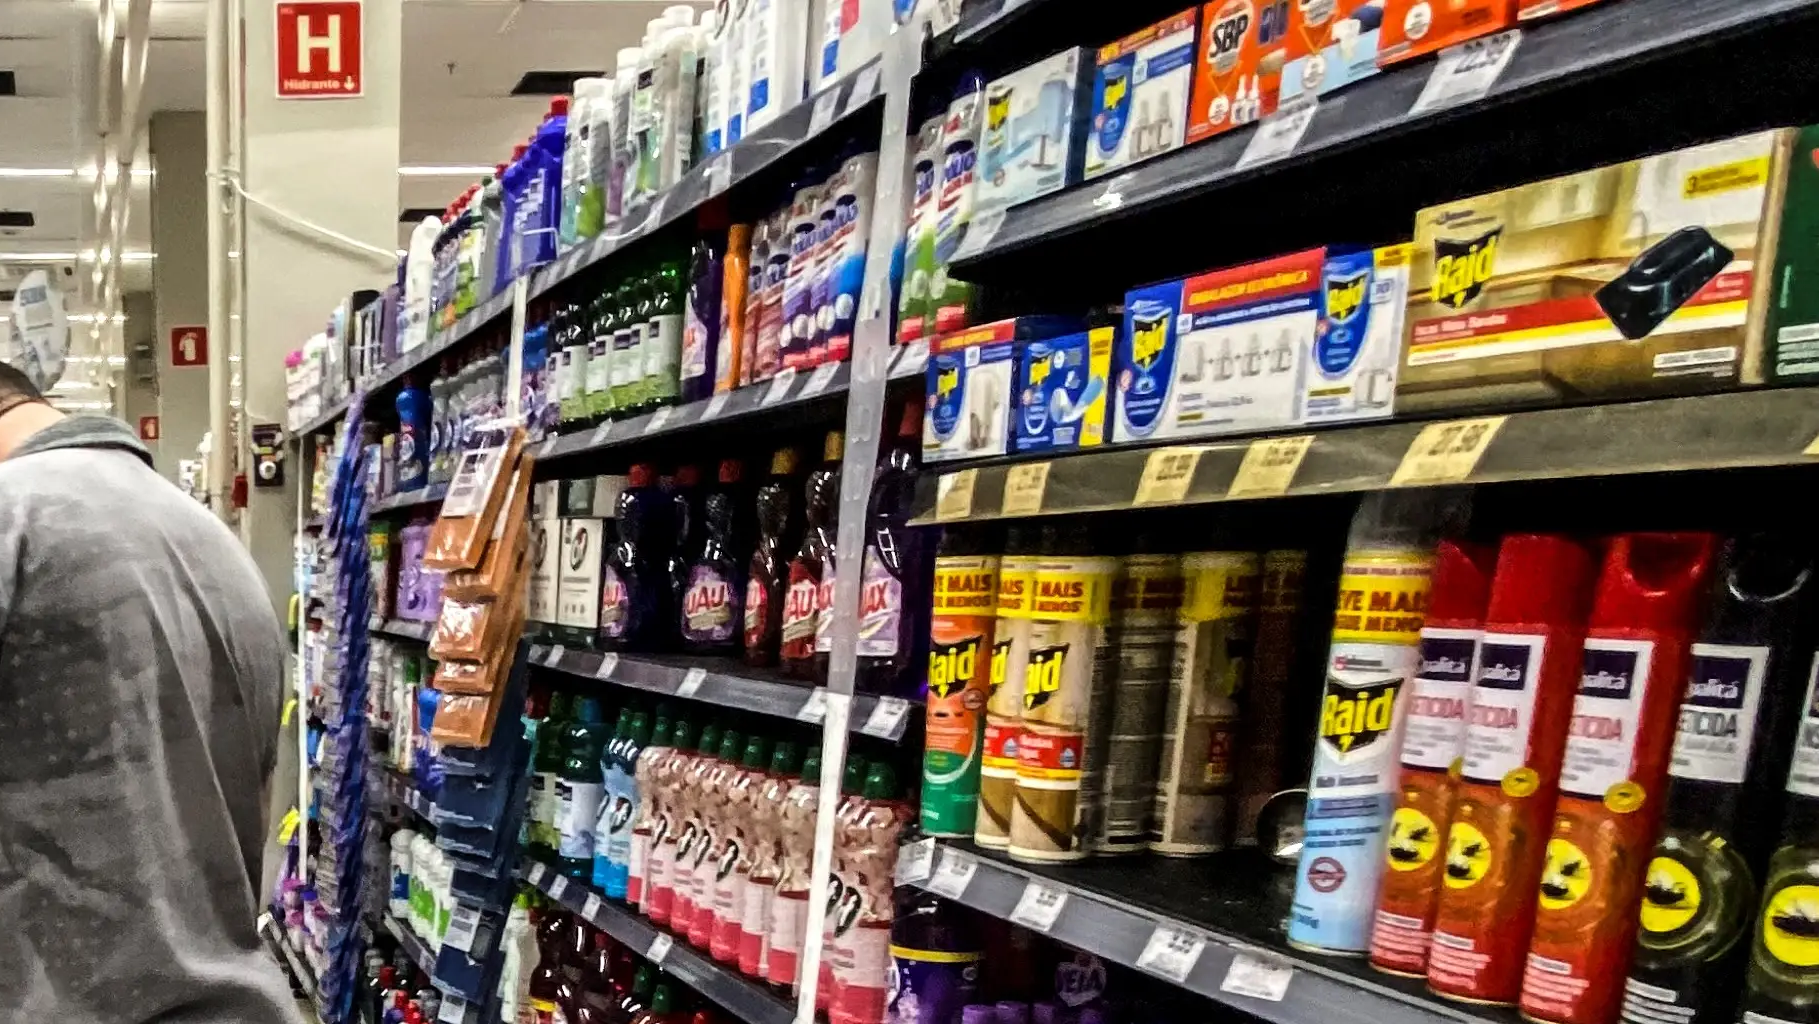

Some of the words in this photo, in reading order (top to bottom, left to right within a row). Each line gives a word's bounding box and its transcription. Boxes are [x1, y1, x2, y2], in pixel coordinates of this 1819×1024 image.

[297, 14, 341, 73] H
[1209, 13, 1249, 58] SBP
[283, 79, 340, 90] Hidrante
[1431, 238, 1497, 303] Raid
[1321, 687, 1394, 737] Raid
